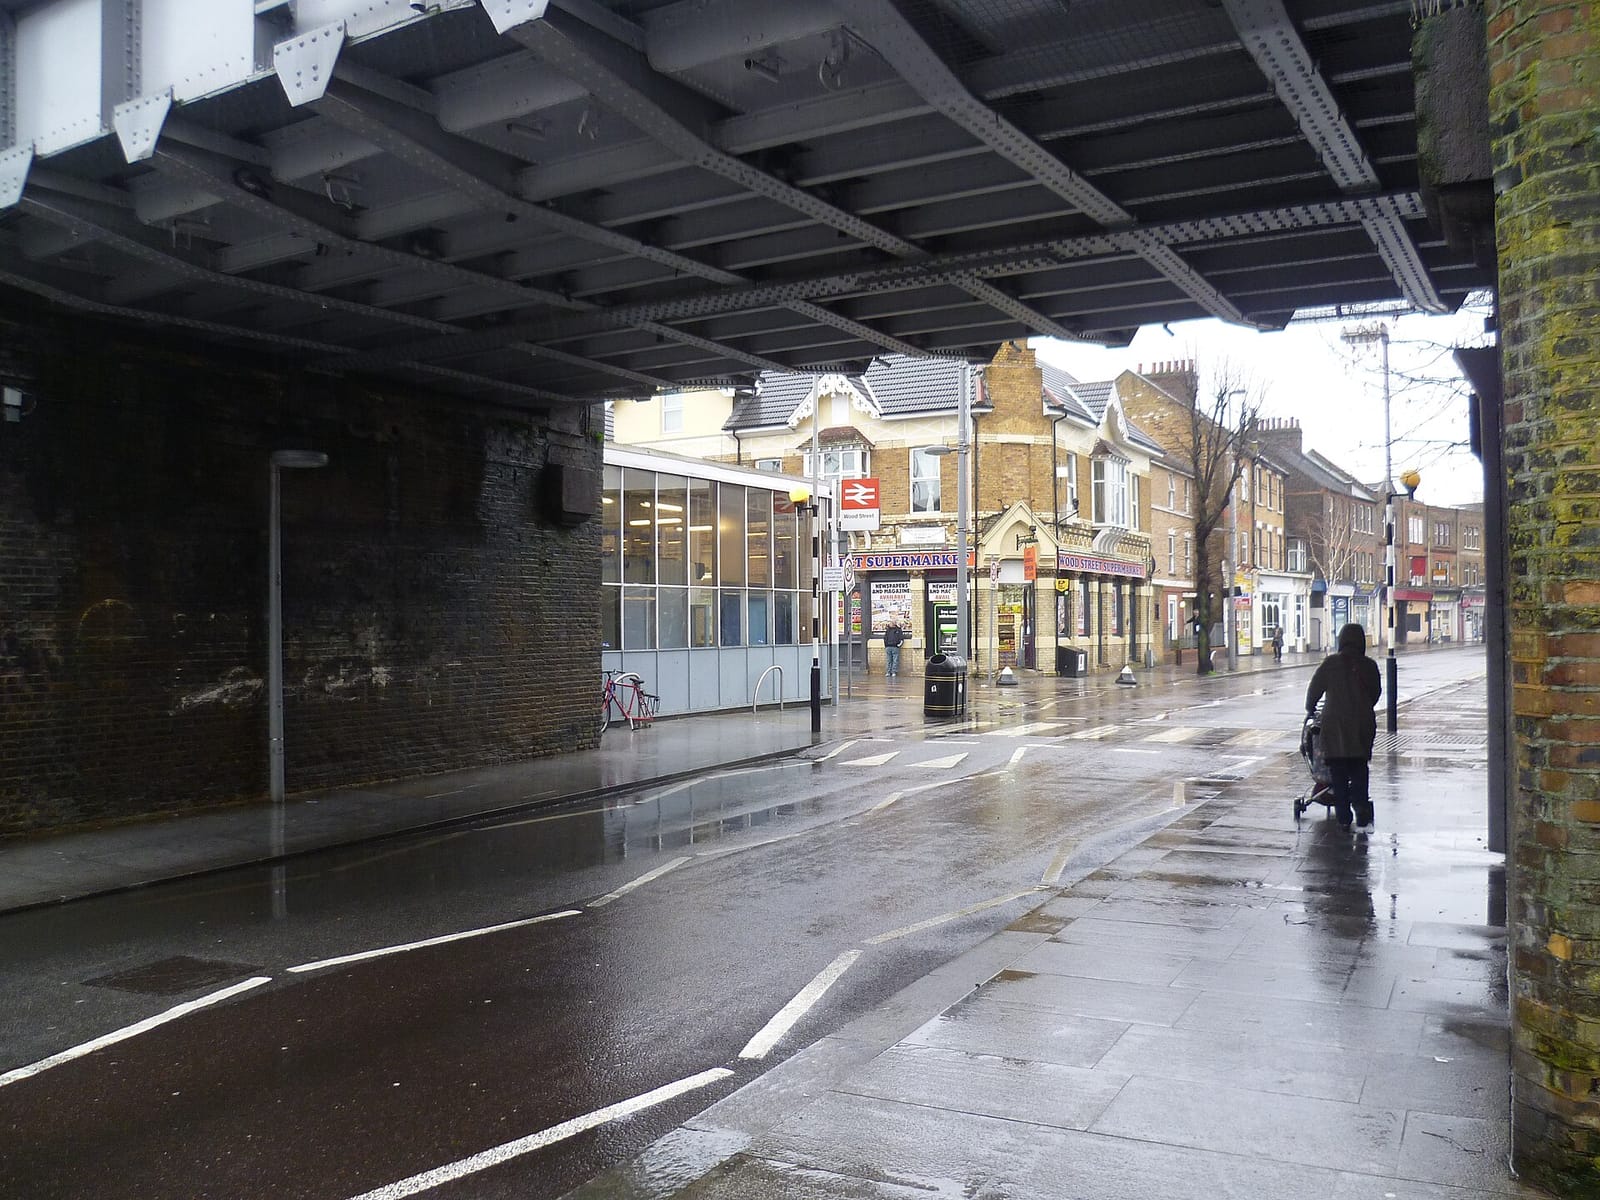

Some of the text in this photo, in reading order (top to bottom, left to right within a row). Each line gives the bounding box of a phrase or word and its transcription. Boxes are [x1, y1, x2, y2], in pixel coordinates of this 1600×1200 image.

[866, 554, 970, 568] SUPERMARKE
[1059, 555, 1143, 575] WOOD STREET SUPERMARKET
